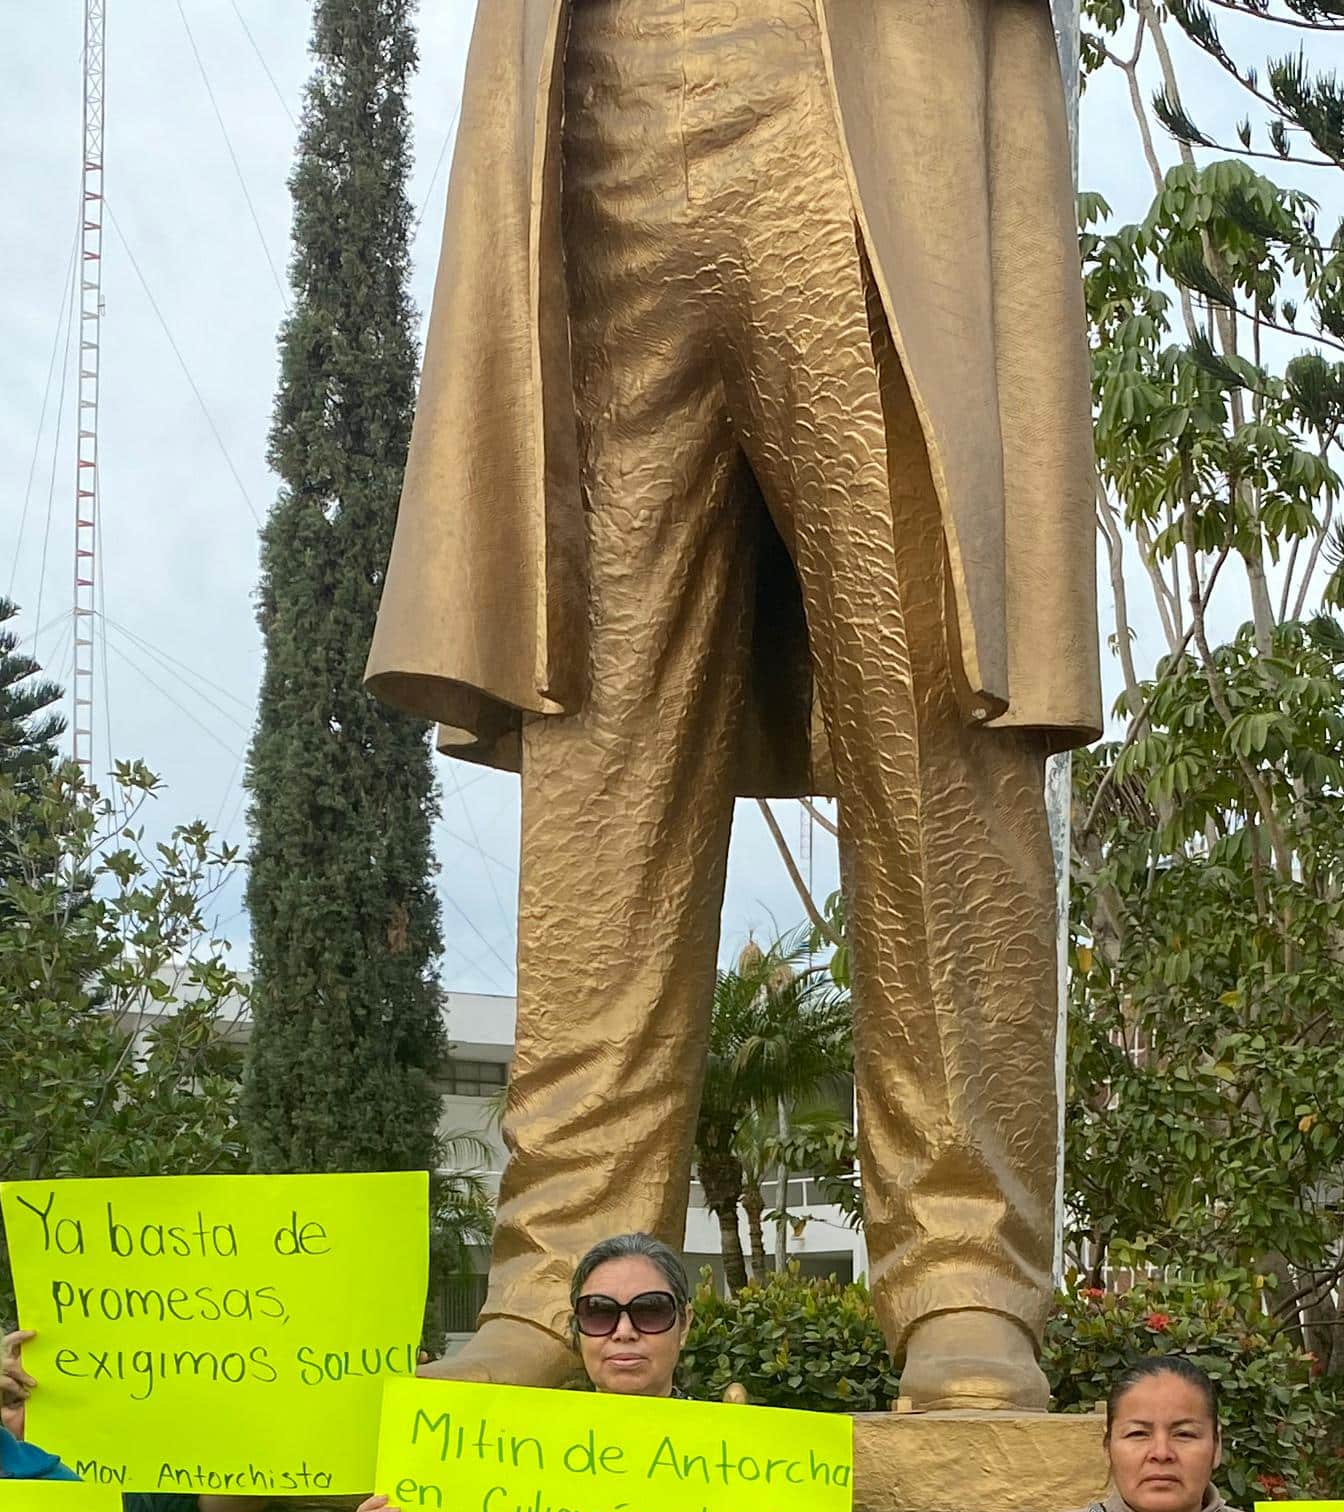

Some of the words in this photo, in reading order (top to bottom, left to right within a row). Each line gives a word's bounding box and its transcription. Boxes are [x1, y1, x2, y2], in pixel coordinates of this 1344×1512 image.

[17, 1192, 83, 1255] Ya
[107, 1202, 237, 1257] basta
[274, 1211, 331, 1255] de
[56, 1345, 278, 1400] exigimos
[158, 1461, 332, 1489] Antorchista
[564, 1430, 625, 1475] de
[648, 1436, 851, 1488] Antorcha
[396, 1477, 442, 1508] en
